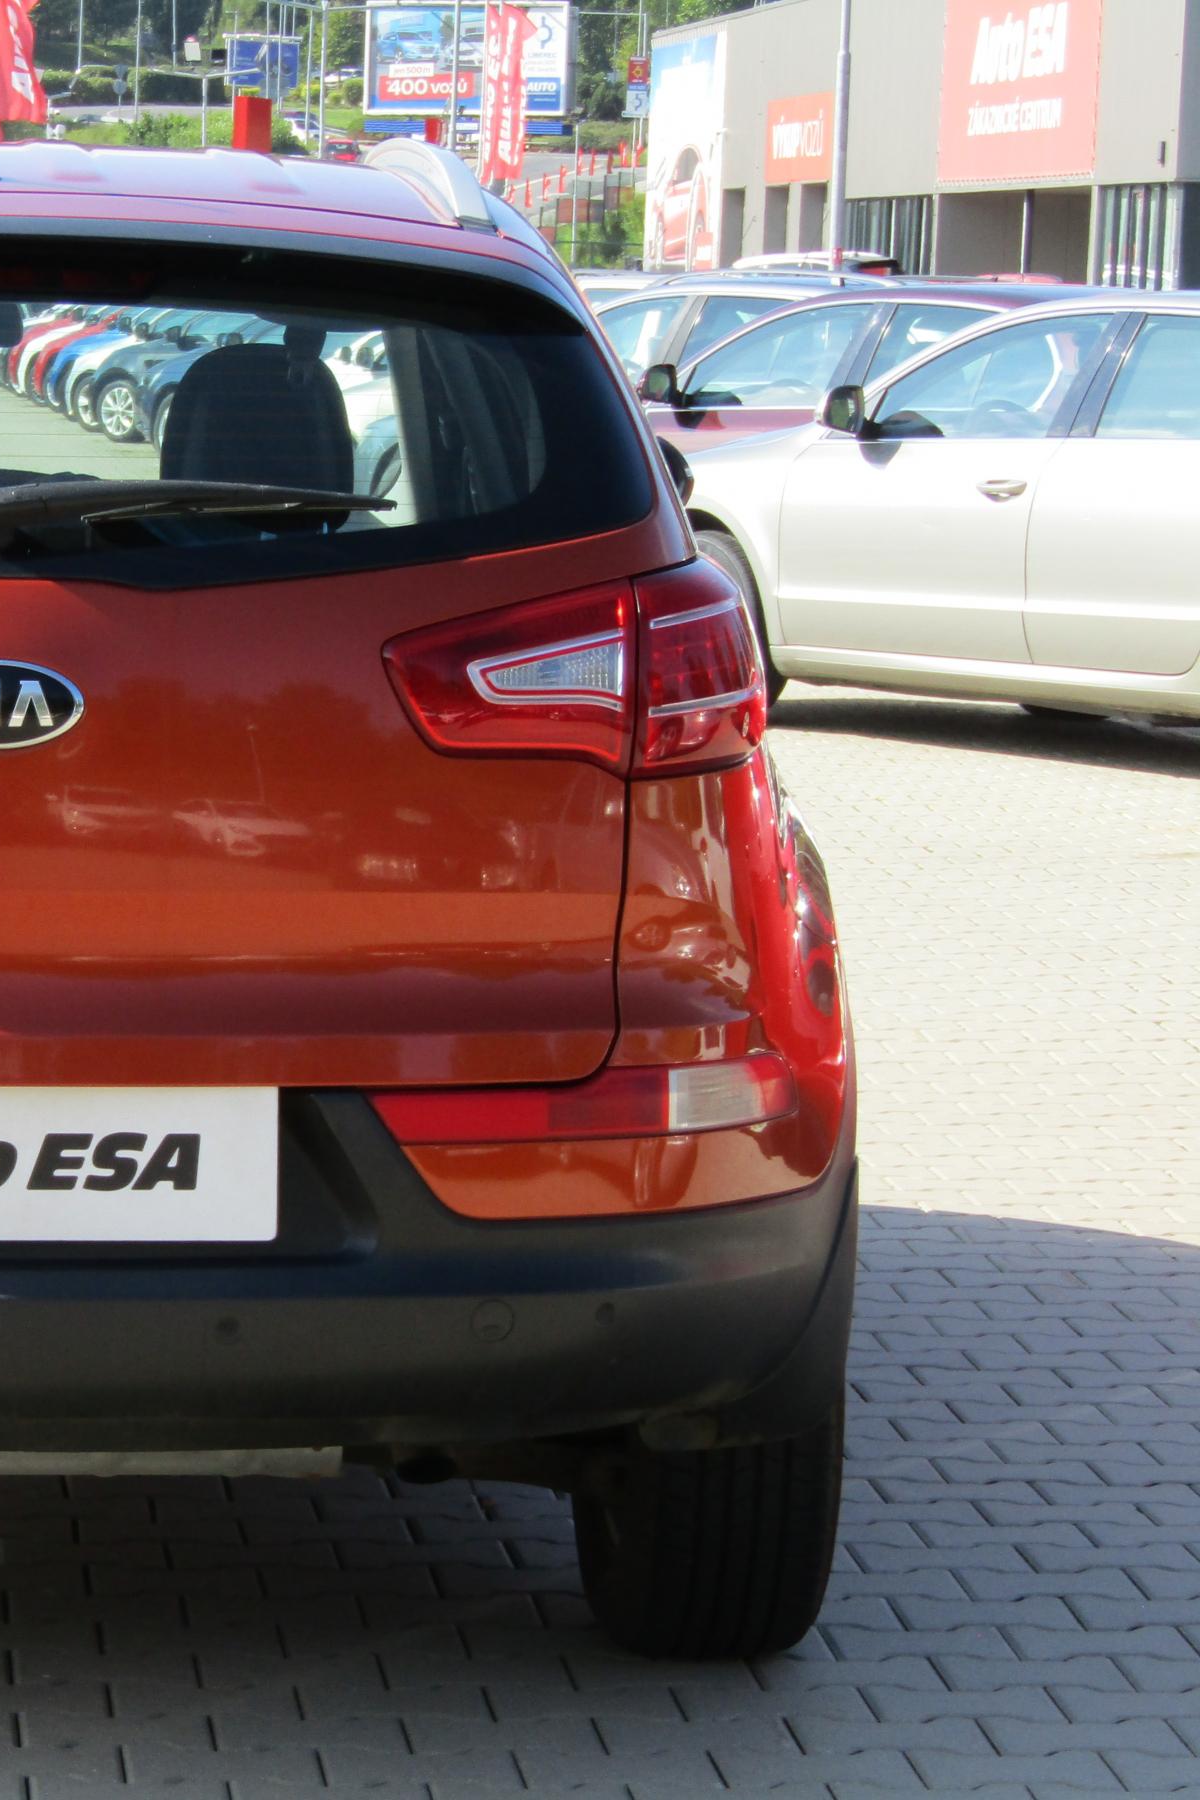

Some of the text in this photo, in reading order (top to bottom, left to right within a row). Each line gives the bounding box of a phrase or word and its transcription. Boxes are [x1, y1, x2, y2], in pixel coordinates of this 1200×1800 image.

[970, 1, 1069, 85] Auto ESA
[387, 78, 428, 96] 400
[26, 1131, 201, 1192] ESA
